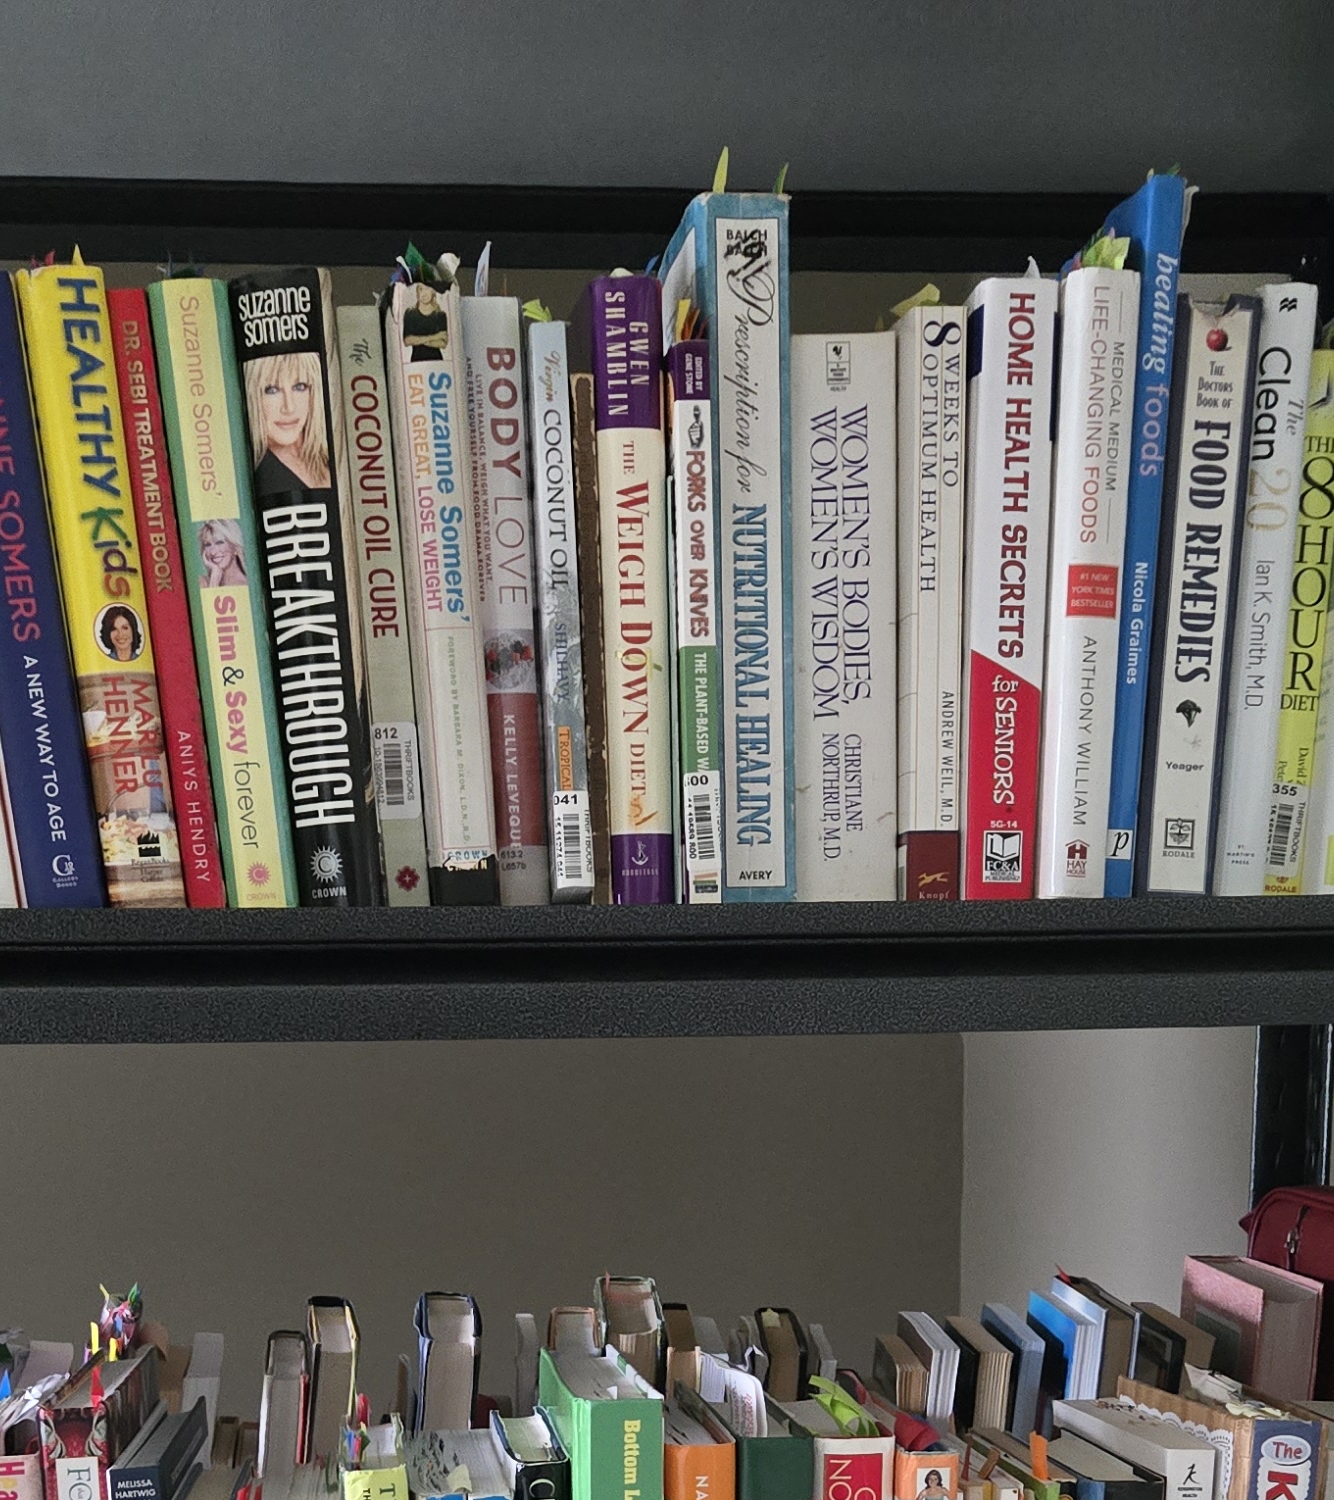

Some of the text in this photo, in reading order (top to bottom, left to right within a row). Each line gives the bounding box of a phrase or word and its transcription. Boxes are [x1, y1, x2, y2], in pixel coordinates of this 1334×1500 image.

[238, 285, 311, 320] suzanne
[244, 316, 309, 347] somers
[56, 276, 132, 600] HEALTHY Kids
[349, 338, 399, 641] The COCONUT OIL CURE
[486, 346, 529, 607] BODY LOVE
[809, 405, 840, 570] WOMEN'S
[997, 291, 1035, 659] HOME HEALTH SECRETS
[616, 440, 655, 796] THE WEIGH DOWN DIET
[840, 404, 873, 707] WOMEN'S BODIES,
[1173, 418, 1232, 684] FOOD REMEDIES
[263, 502, 355, 828] BREAKTHROUGH
[811, 576, 840, 720] WISDOM
[993, 675, 1018, 694] for
[21, 655, 66, 842] A NEW WAY TO AGE
[993, 695, 1016, 805] SENIORS
[312, 884, 347, 898] CROWN
[739, 870, 772, 881] AVERY
[1271, 1443, 1303, 1458] The
